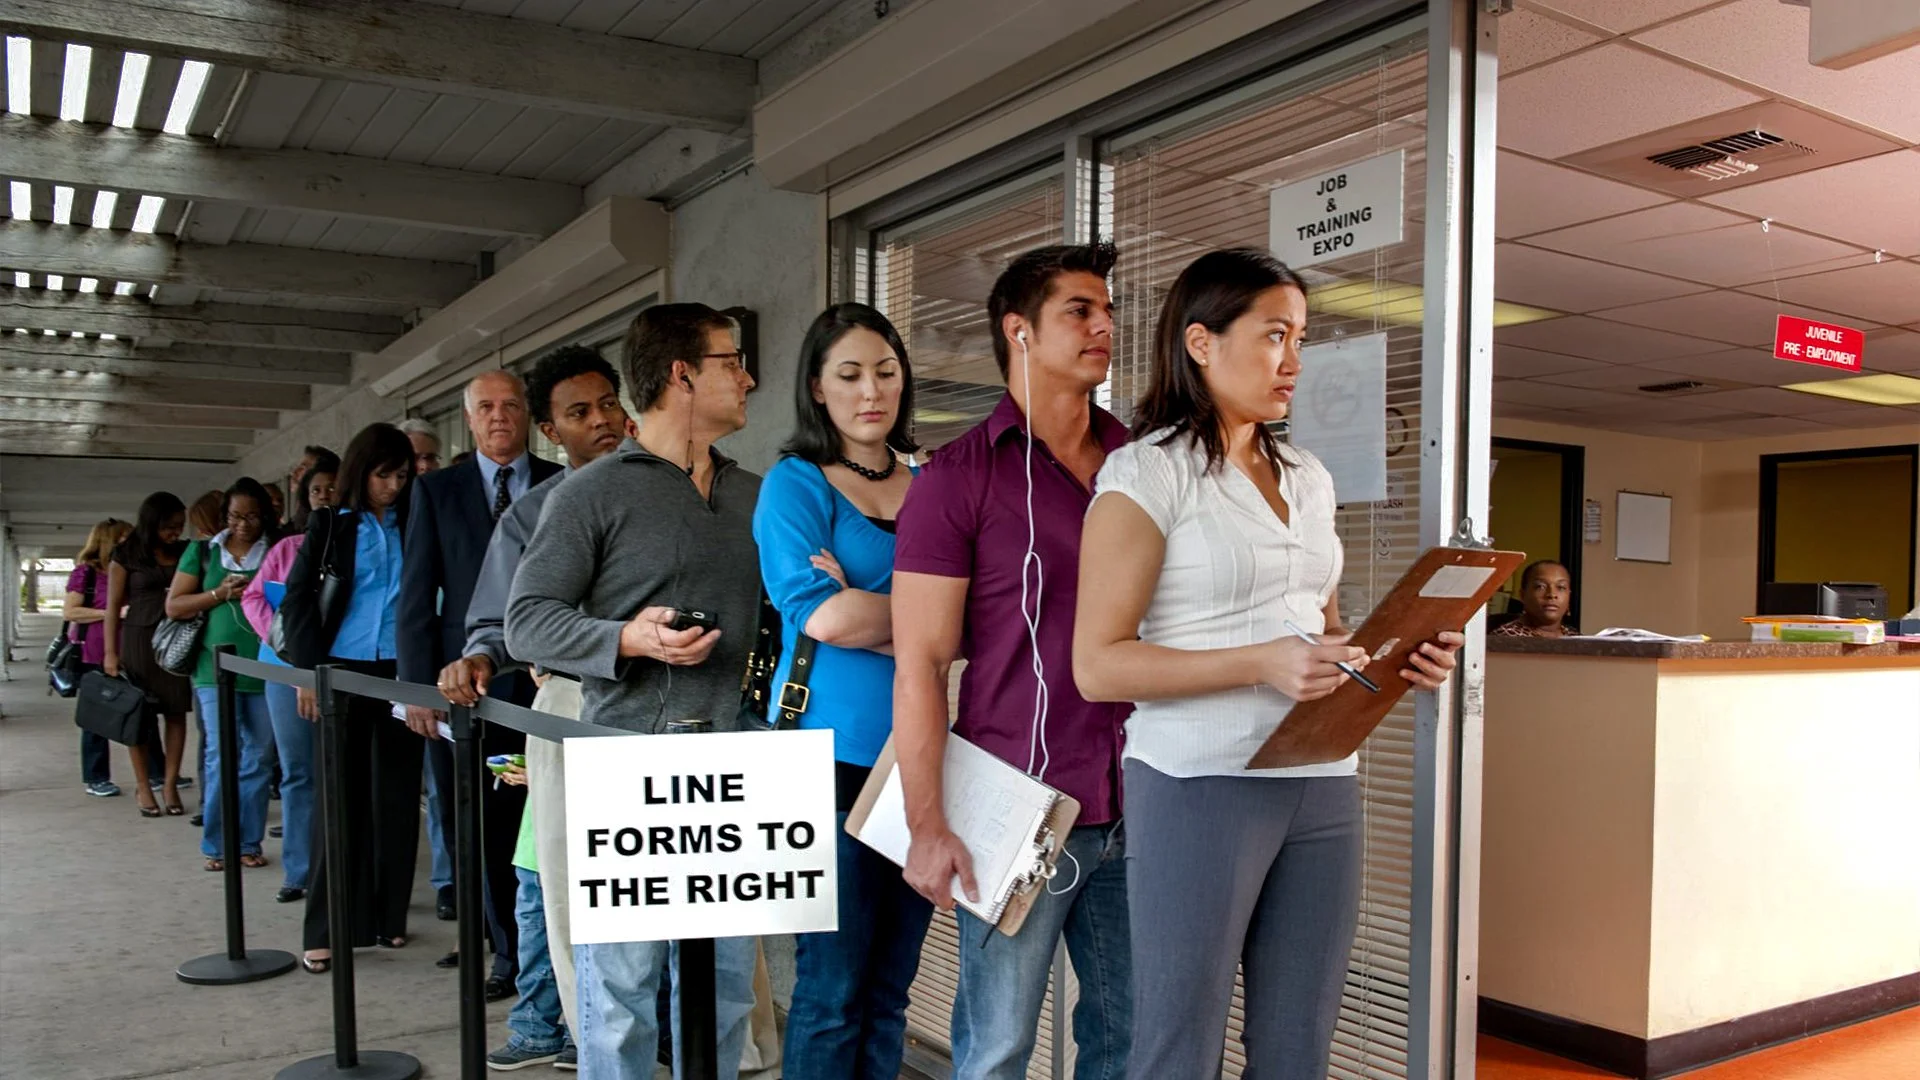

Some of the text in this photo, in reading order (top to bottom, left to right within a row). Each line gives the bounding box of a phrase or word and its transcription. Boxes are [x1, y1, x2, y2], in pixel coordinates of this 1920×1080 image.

[1316, 174, 1347, 195] JOB
[1326, 198, 1337, 212] &
[1297, 207, 1372, 240] TRAINING
[1313, 233, 1354, 256] EXPO
[1805, 326, 1844, 343] JUVENILE
[1783, 341, 1801, 356] PRE
[1806, 346, 1856, 365] EMPLOYMENT
[643, 773, 745, 805] LINE
[587, 820, 815, 857] FORMS TO
[580, 870, 824, 908] THE RIGHT
